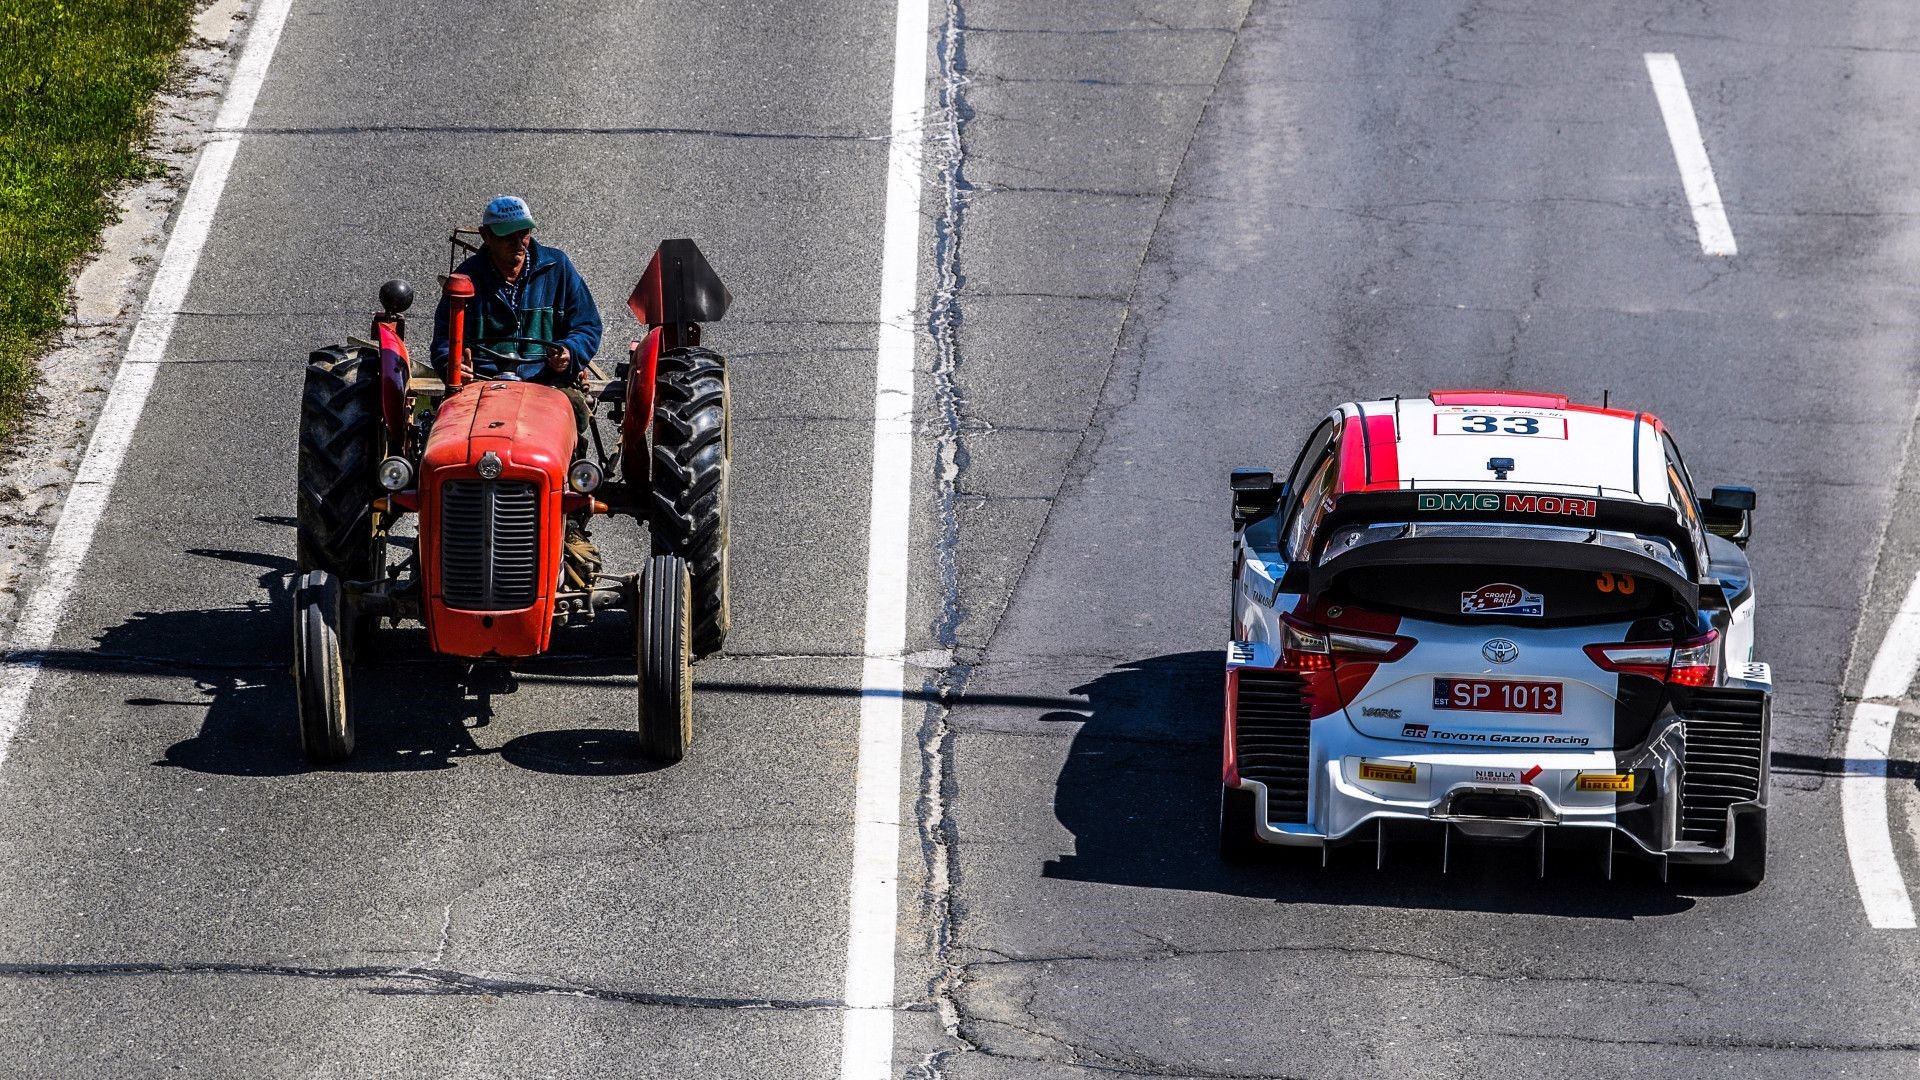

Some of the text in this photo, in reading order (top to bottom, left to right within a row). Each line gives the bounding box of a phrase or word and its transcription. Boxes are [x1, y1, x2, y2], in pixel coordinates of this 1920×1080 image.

[1462, 415, 1539, 435] 33
[1418, 494, 1597, 517] DMG MORI
[1484, 591, 1516, 599] CROATIA
[1434, 698, 1449, 706] EST
[1454, 683, 1557, 710] SP 1013
[1403, 728, 1427, 738] GR
[1431, 730, 1590, 746] TOYOTA GAZOO Racing
[1363, 765, 1413, 780] PIRELLI
[1475, 770, 1516, 778] NISULA
[1580, 777, 1630, 789] PIRELLI
